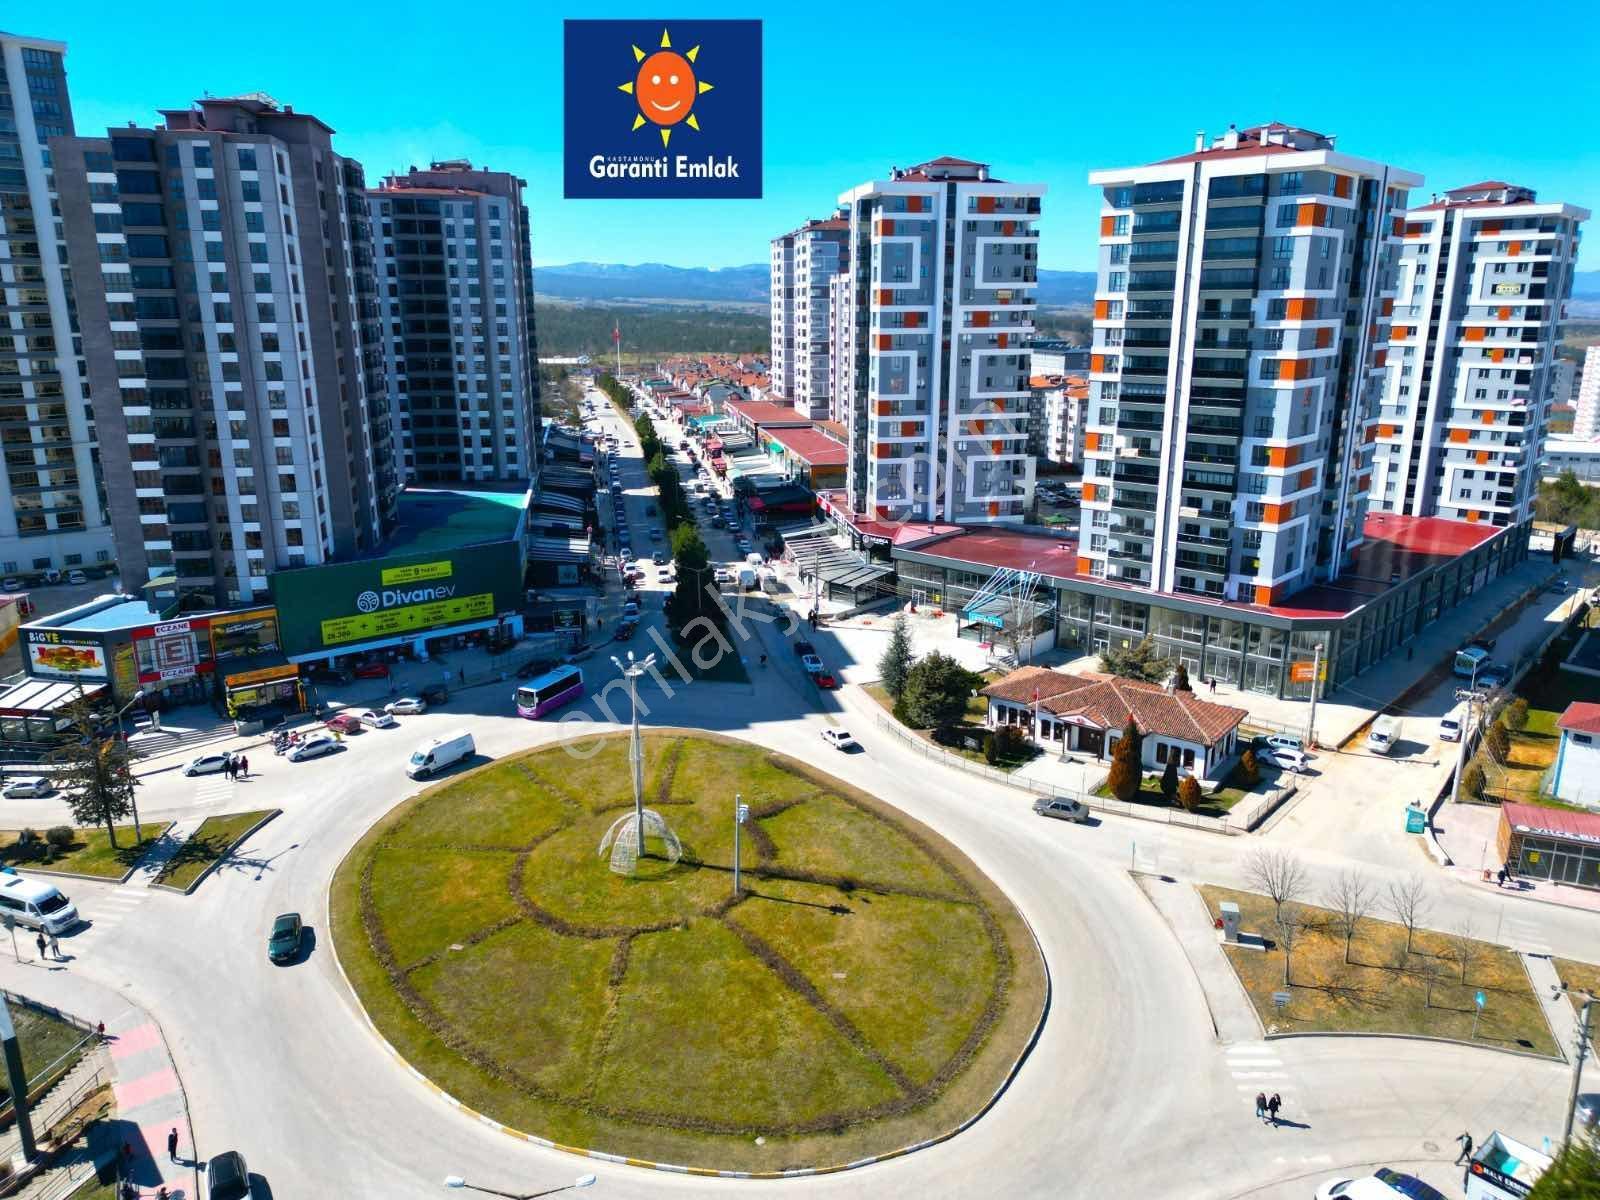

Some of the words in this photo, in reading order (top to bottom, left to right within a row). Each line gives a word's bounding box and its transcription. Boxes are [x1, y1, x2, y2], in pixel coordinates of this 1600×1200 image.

[382, 584, 455, 608] Divanev
[156, 622, 188, 634] ECZANE
[161, 666, 195, 678] ECZANE
